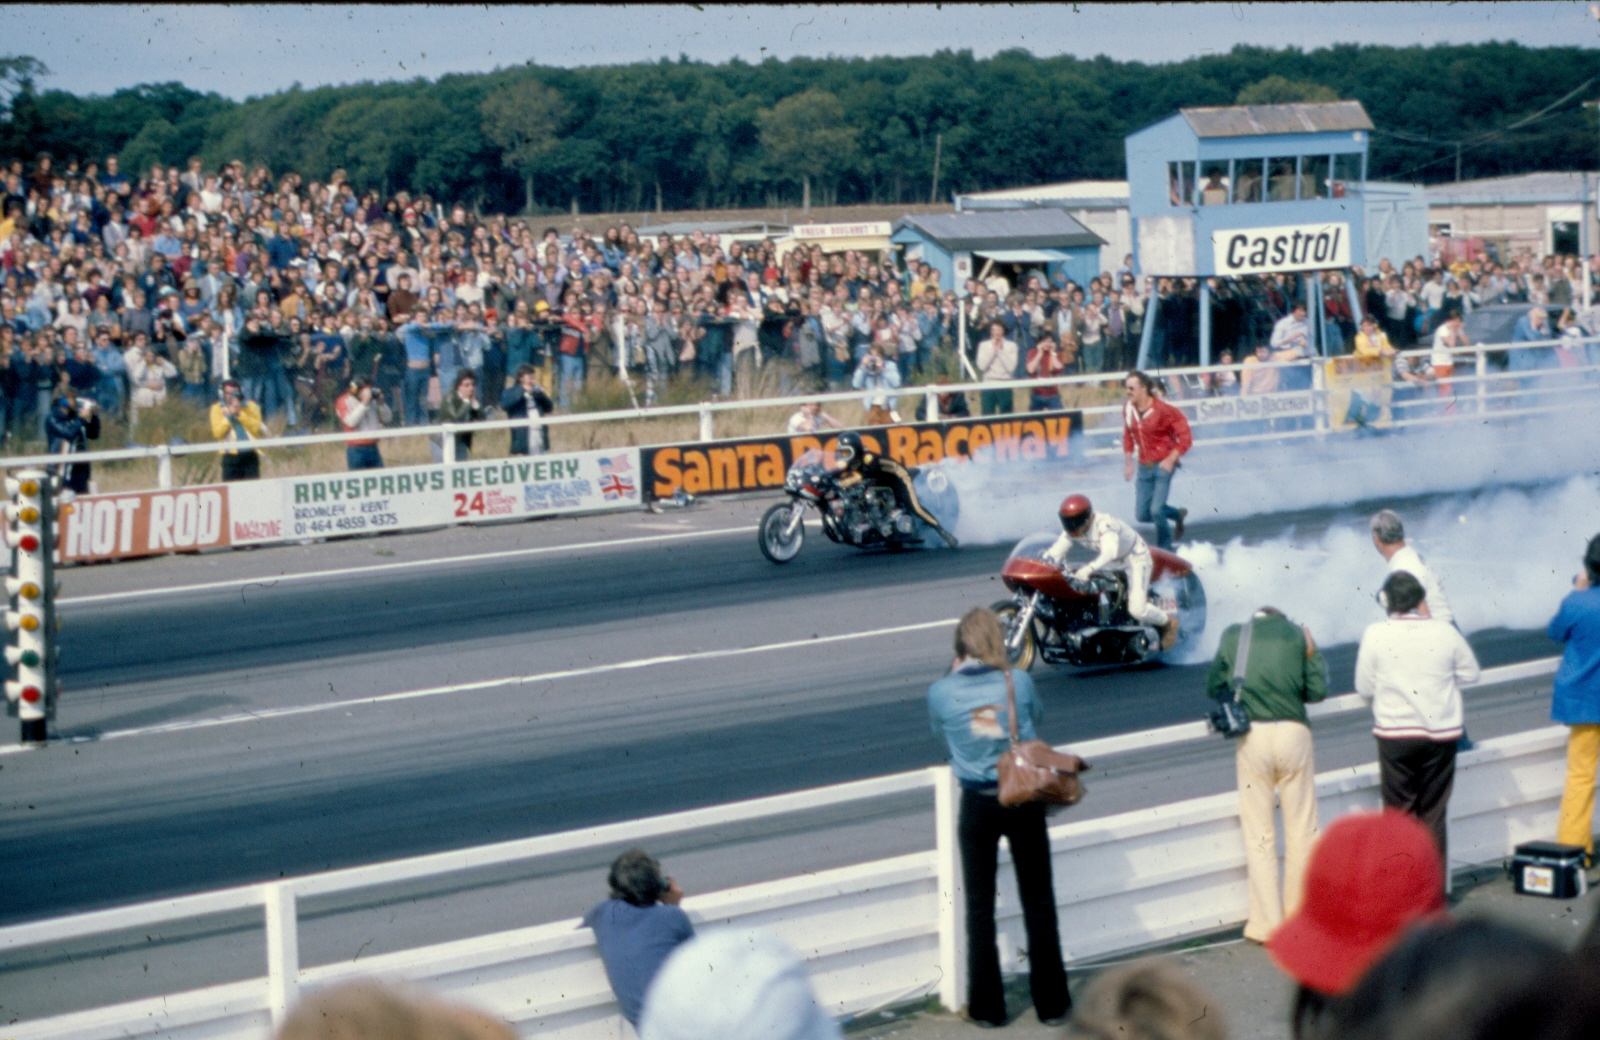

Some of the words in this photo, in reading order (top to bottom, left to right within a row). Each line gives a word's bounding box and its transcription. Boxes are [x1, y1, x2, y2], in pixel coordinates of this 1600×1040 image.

[1226, 227, 1341, 269] Castrol
[887, 417, 1071, 468] Raceway
[294, 470, 445, 504] RAYSPRAYS
[452, 459, 580, 489] RECOVERY
[65, 497, 141, 557] HOT
[148, 490, 222, 550] ROD
[360, 500, 390, 514] KENT
[453, 491, 486, 518] 24
